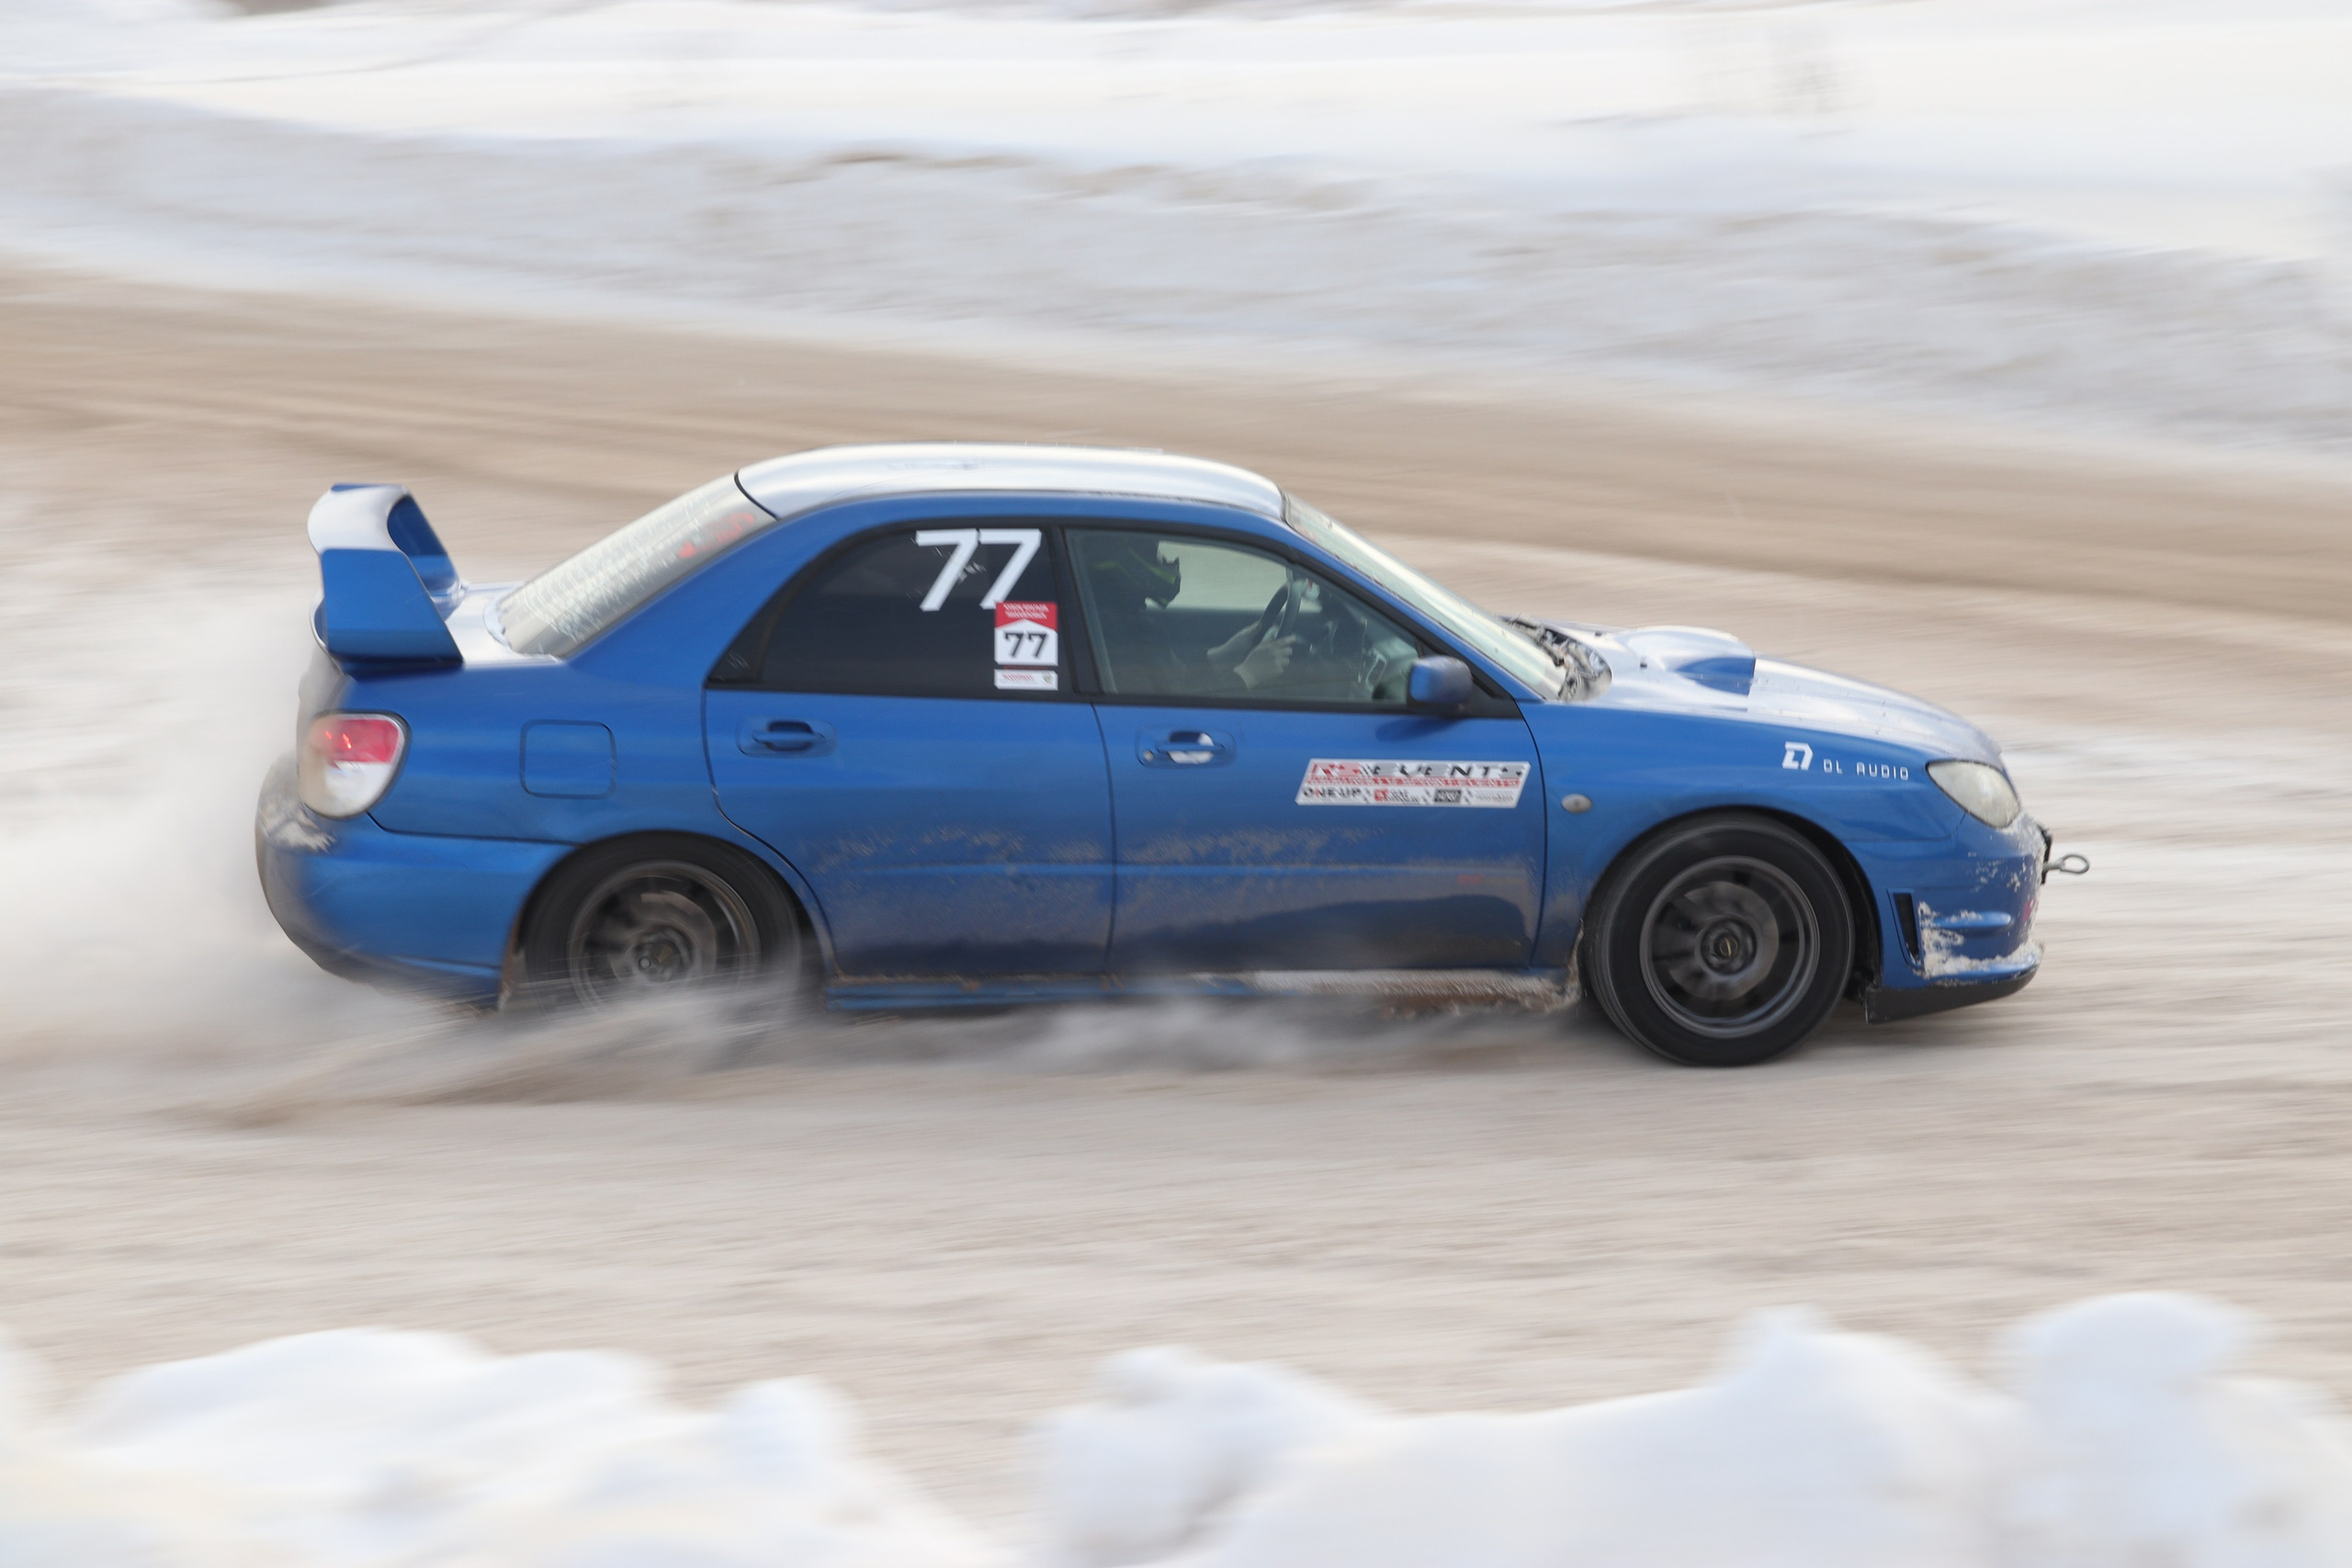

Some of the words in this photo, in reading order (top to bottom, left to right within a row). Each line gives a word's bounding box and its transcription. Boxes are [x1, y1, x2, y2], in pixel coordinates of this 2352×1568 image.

[916, 528, 1042, 611] 77
[1004, 632, 1048, 659] 77
[1371, 762, 1526, 779] EVENTS
[1824, 759, 1842, 773] DL
[1856, 761, 1908, 781] AUDIO
